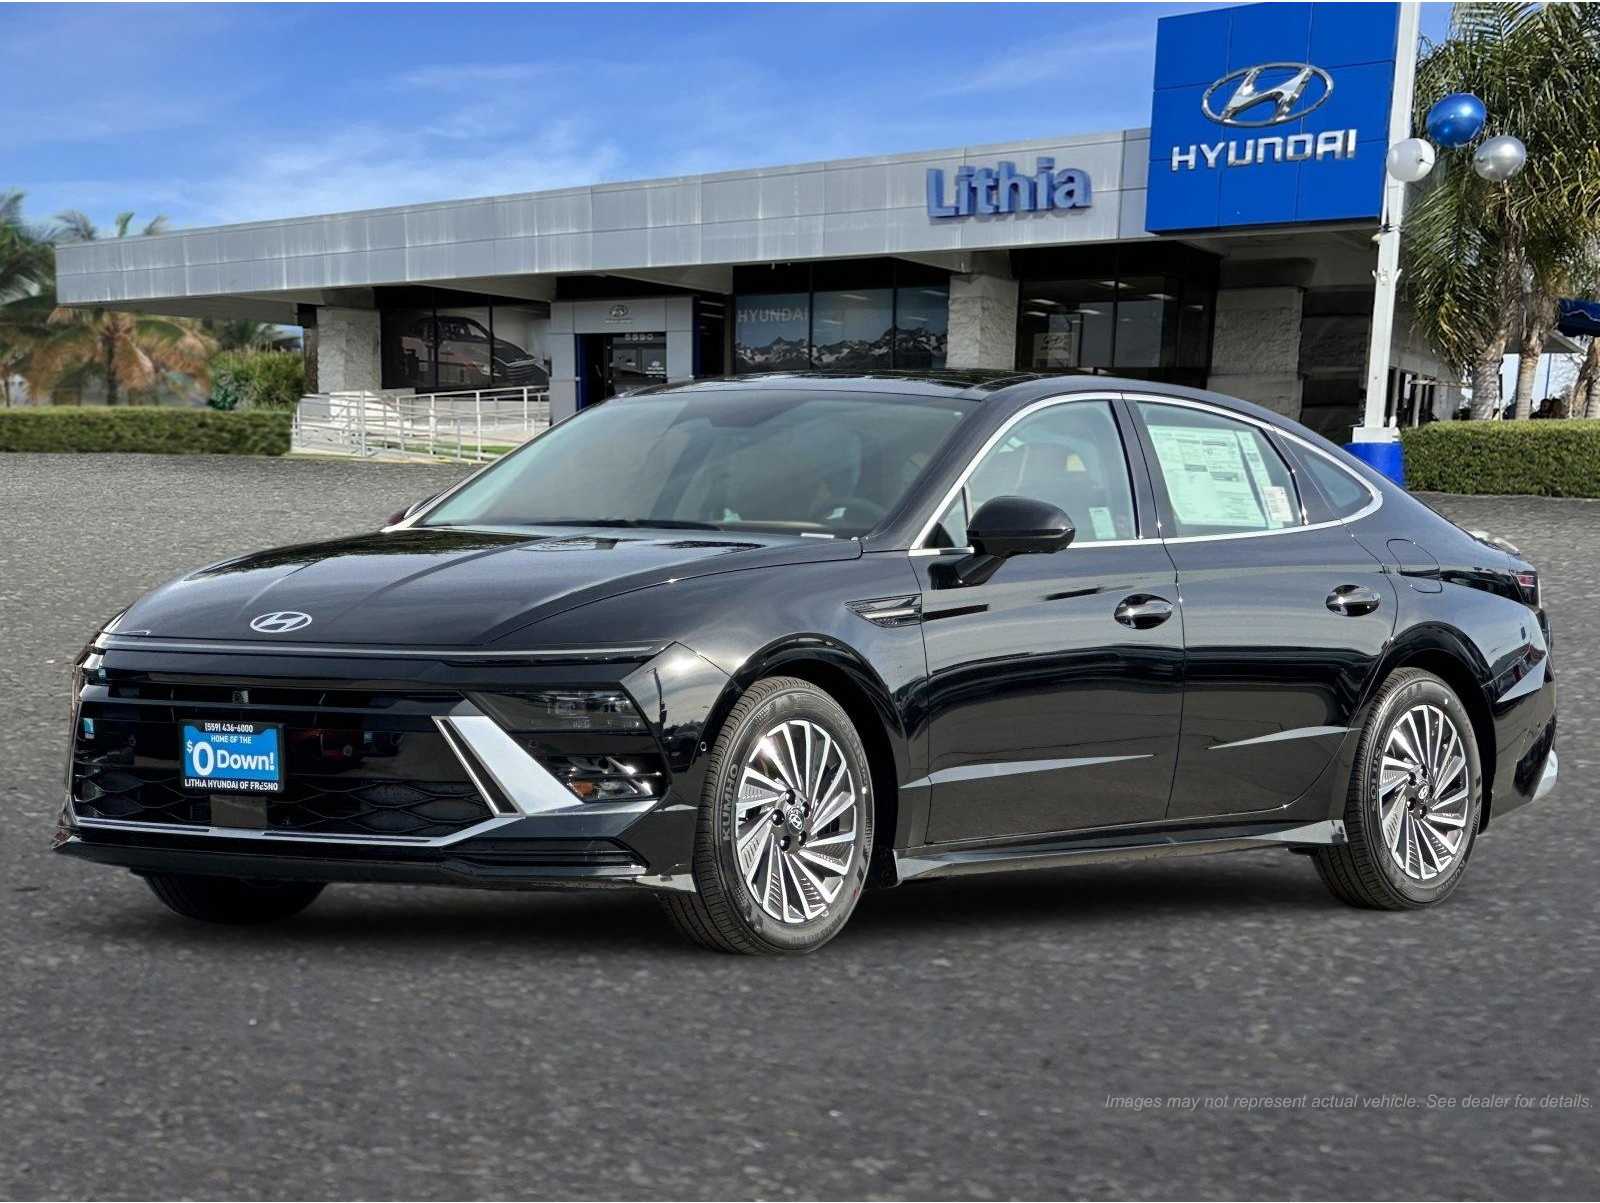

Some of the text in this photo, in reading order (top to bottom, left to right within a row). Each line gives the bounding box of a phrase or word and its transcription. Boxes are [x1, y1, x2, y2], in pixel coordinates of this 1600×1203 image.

[1171, 129, 1357, 171] HYUNDAI
[926, 157, 1092, 221] Lithia
[737, 307, 808, 324] HYUNDAI
[222, 723, 254, 734] 436-6000
[210, 734, 252, 745] HOME OF THE
[216, 749, 275, 771] Down!
[208, 779, 239, 790] HYUNDAI
[240, 780, 249, 790] OF
